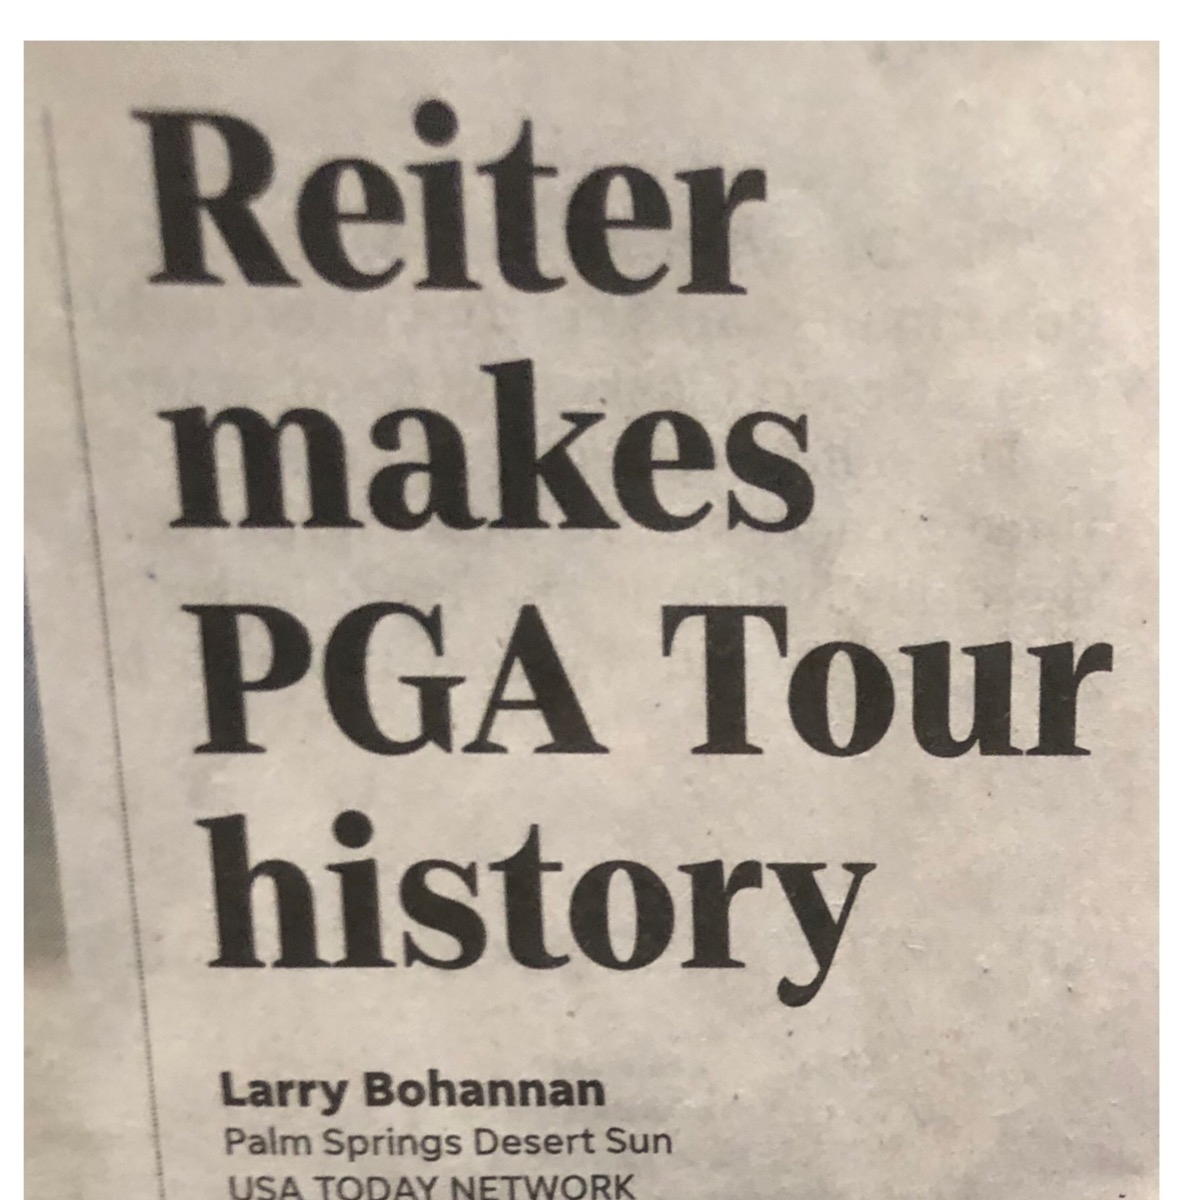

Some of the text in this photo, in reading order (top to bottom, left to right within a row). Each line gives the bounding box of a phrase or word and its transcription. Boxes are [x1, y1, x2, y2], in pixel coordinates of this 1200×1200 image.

[132, 98, 767, 296] Reiter
[157, 358, 815, 533] makes
[180, 601, 1113, 758] PGA Tour
[195, 810, 877, 1008] history
[219, 1068, 606, 1118] Larry Bohannan
[224, 1126, 673, 1163] Palm Springs Desert Sun
